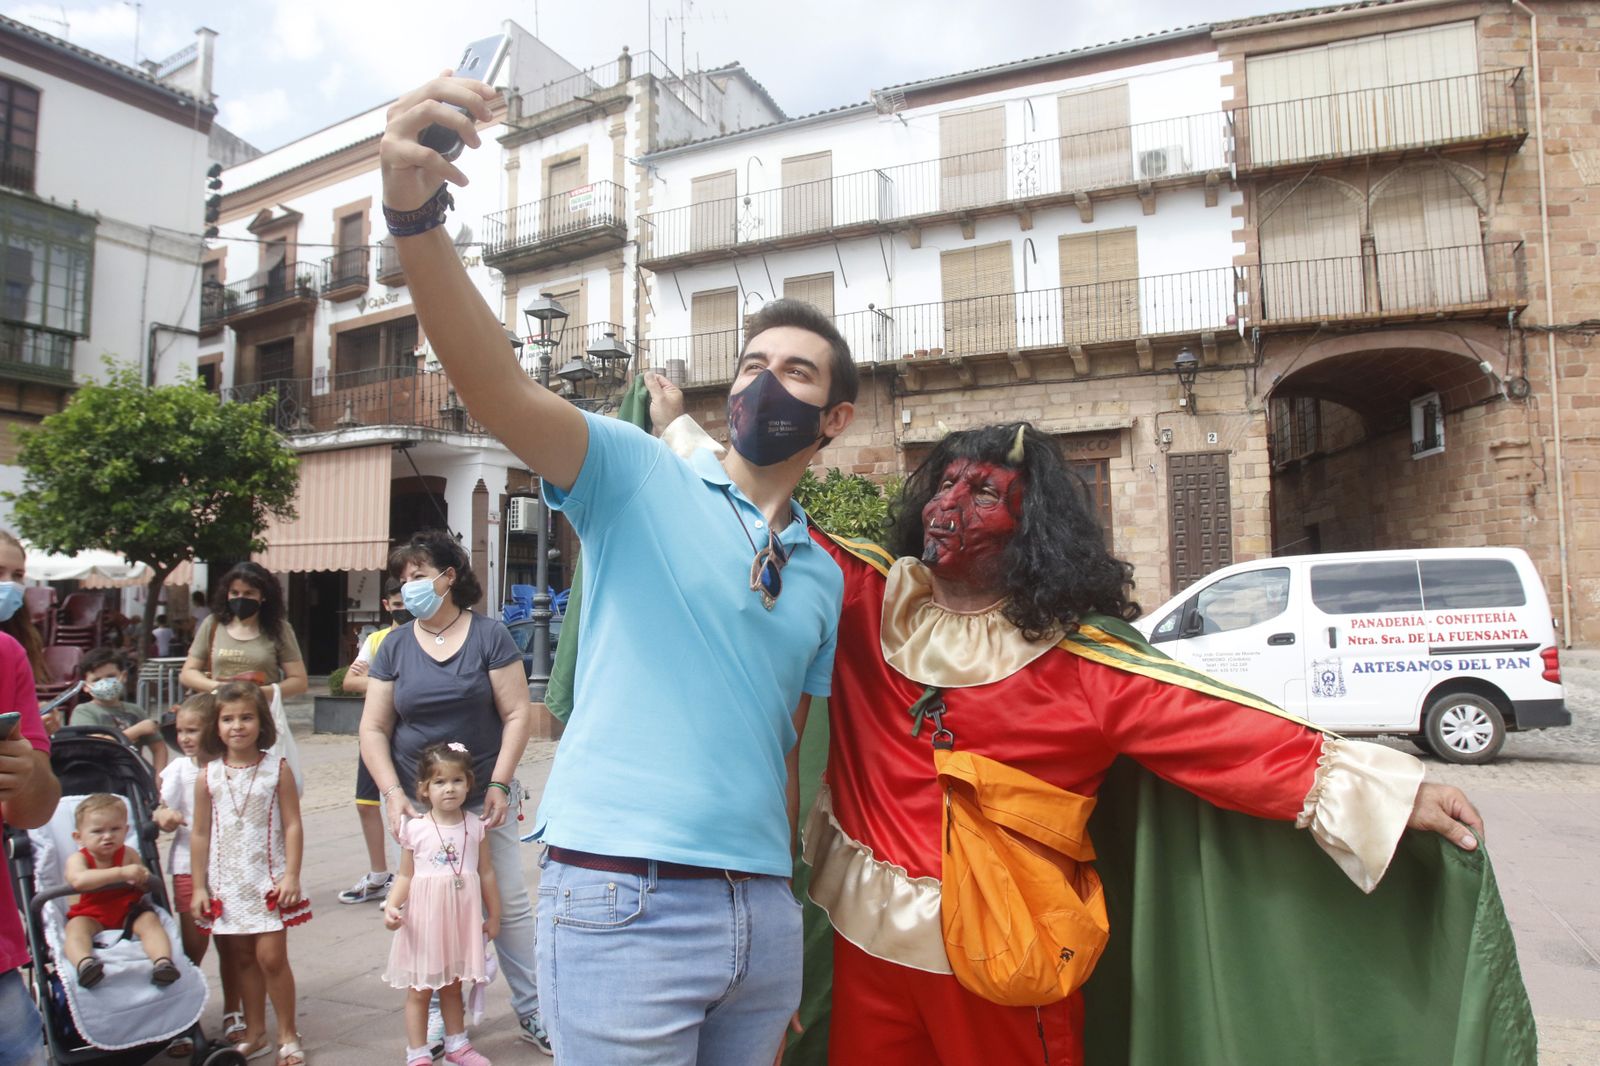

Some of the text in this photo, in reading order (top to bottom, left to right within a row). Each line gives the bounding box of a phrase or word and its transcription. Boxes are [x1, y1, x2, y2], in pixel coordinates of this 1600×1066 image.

[1351, 615, 1425, 629] PANADERÍA
[1436, 611, 1517, 625] CONFITERÍA
[1348, 629, 1529, 646] Ntra. Sra. DE LA FUENSANTA
[1352, 657, 1531, 674] ARTESANOS DEL PAN
